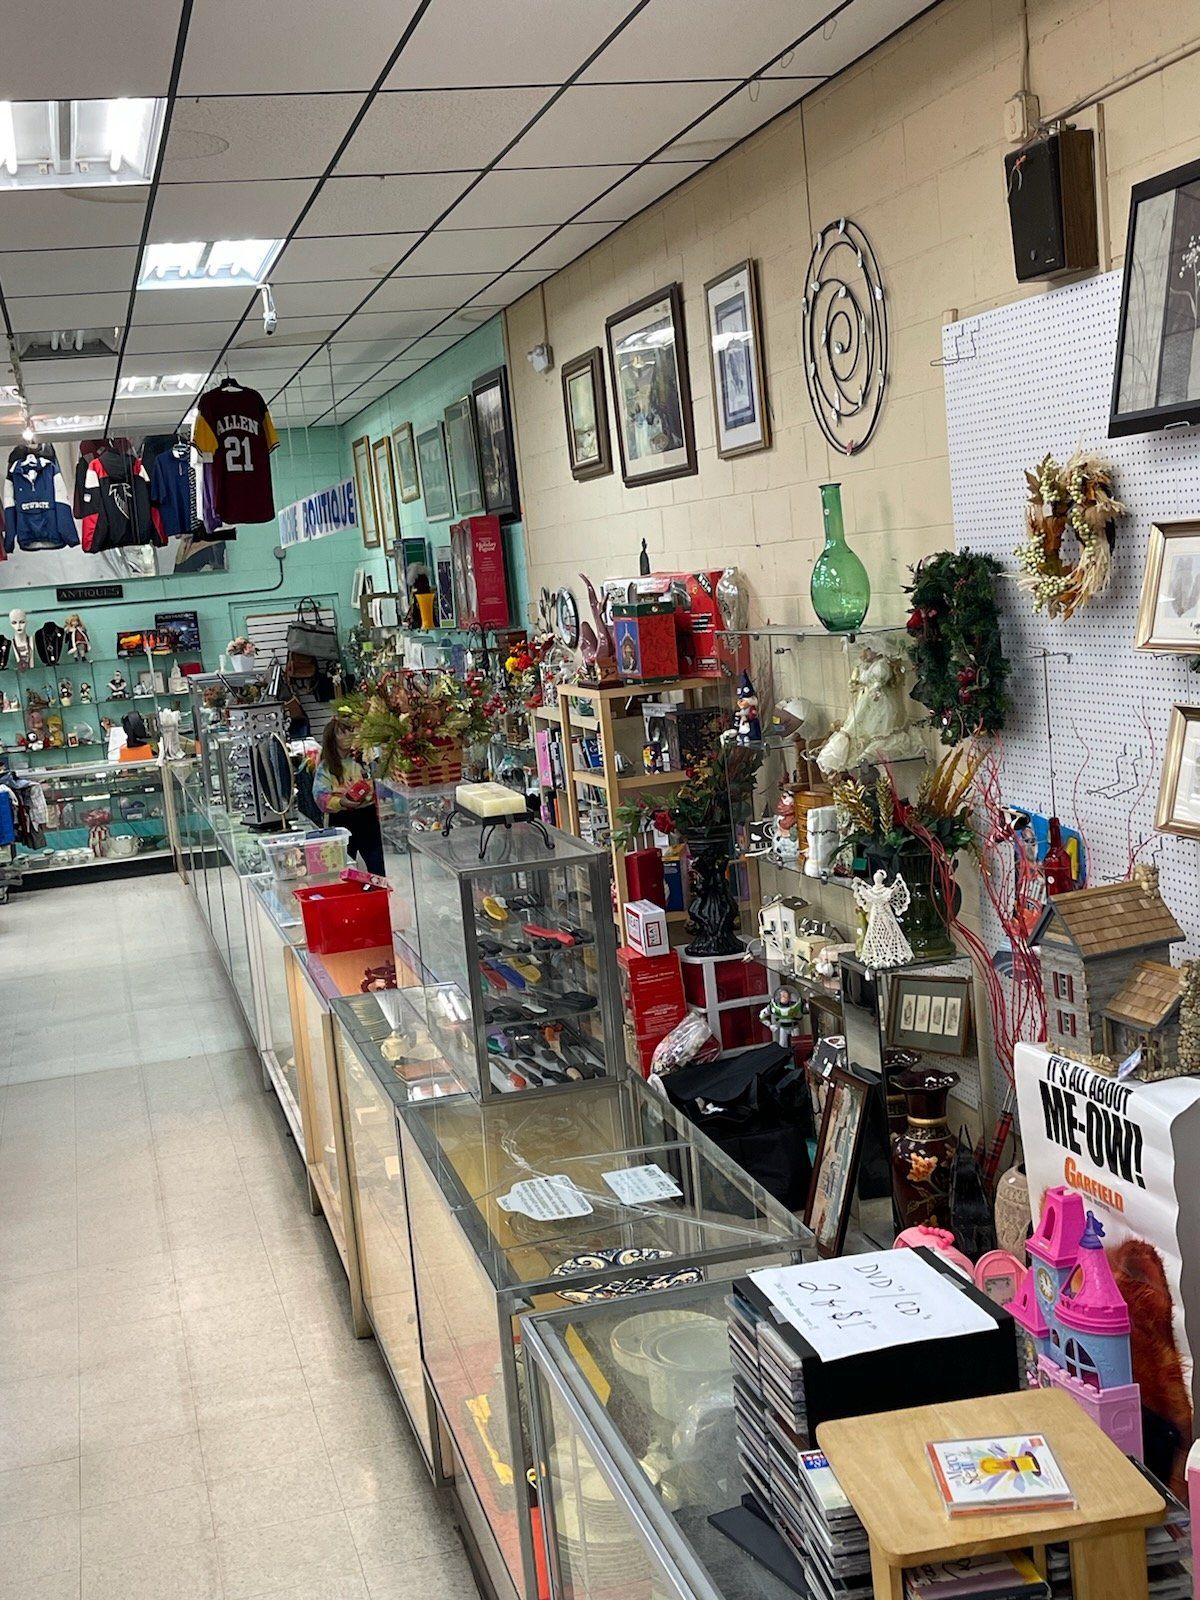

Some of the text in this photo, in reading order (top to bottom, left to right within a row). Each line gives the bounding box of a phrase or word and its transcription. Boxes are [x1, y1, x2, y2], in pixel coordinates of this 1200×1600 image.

[217, 414, 259, 436] ALLEN
[224, 436, 254, 472] 21
[302, 480, 355, 538] BOUTIQUE
[59, 587, 120, 599] ANTIQUES
[1047, 1056, 1134, 1116] IT'S ALL ABOUT
[1039, 1079, 1146, 1189] ME-OW!
[1064, 1156, 1124, 1213] GARFIELD
